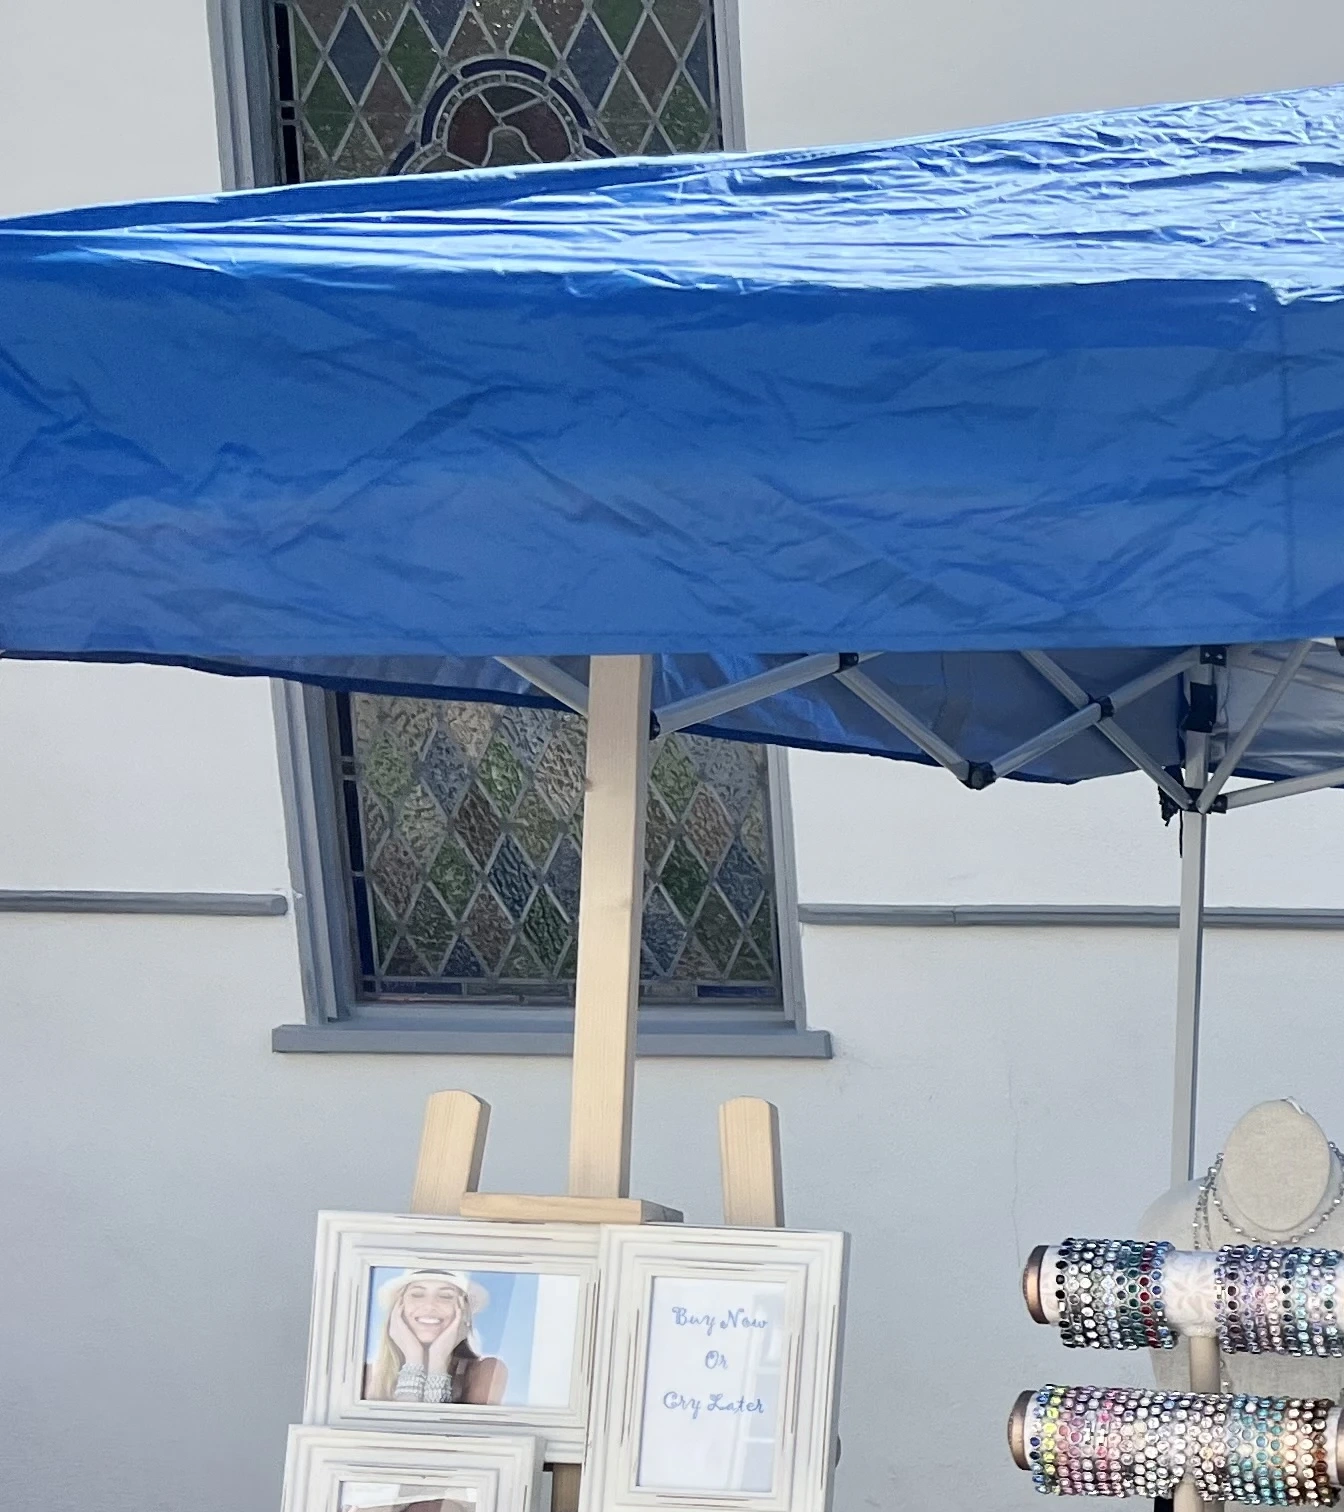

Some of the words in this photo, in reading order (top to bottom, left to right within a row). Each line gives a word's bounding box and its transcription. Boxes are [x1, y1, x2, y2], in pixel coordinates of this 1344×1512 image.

[672, 1306, 716, 1336] Buy
[720, 1308, 768, 1329] Now
[705, 1350, 728, 1369] Or
[663, 1391, 701, 1419] Cry
[707, 1393, 764, 1413] Later
